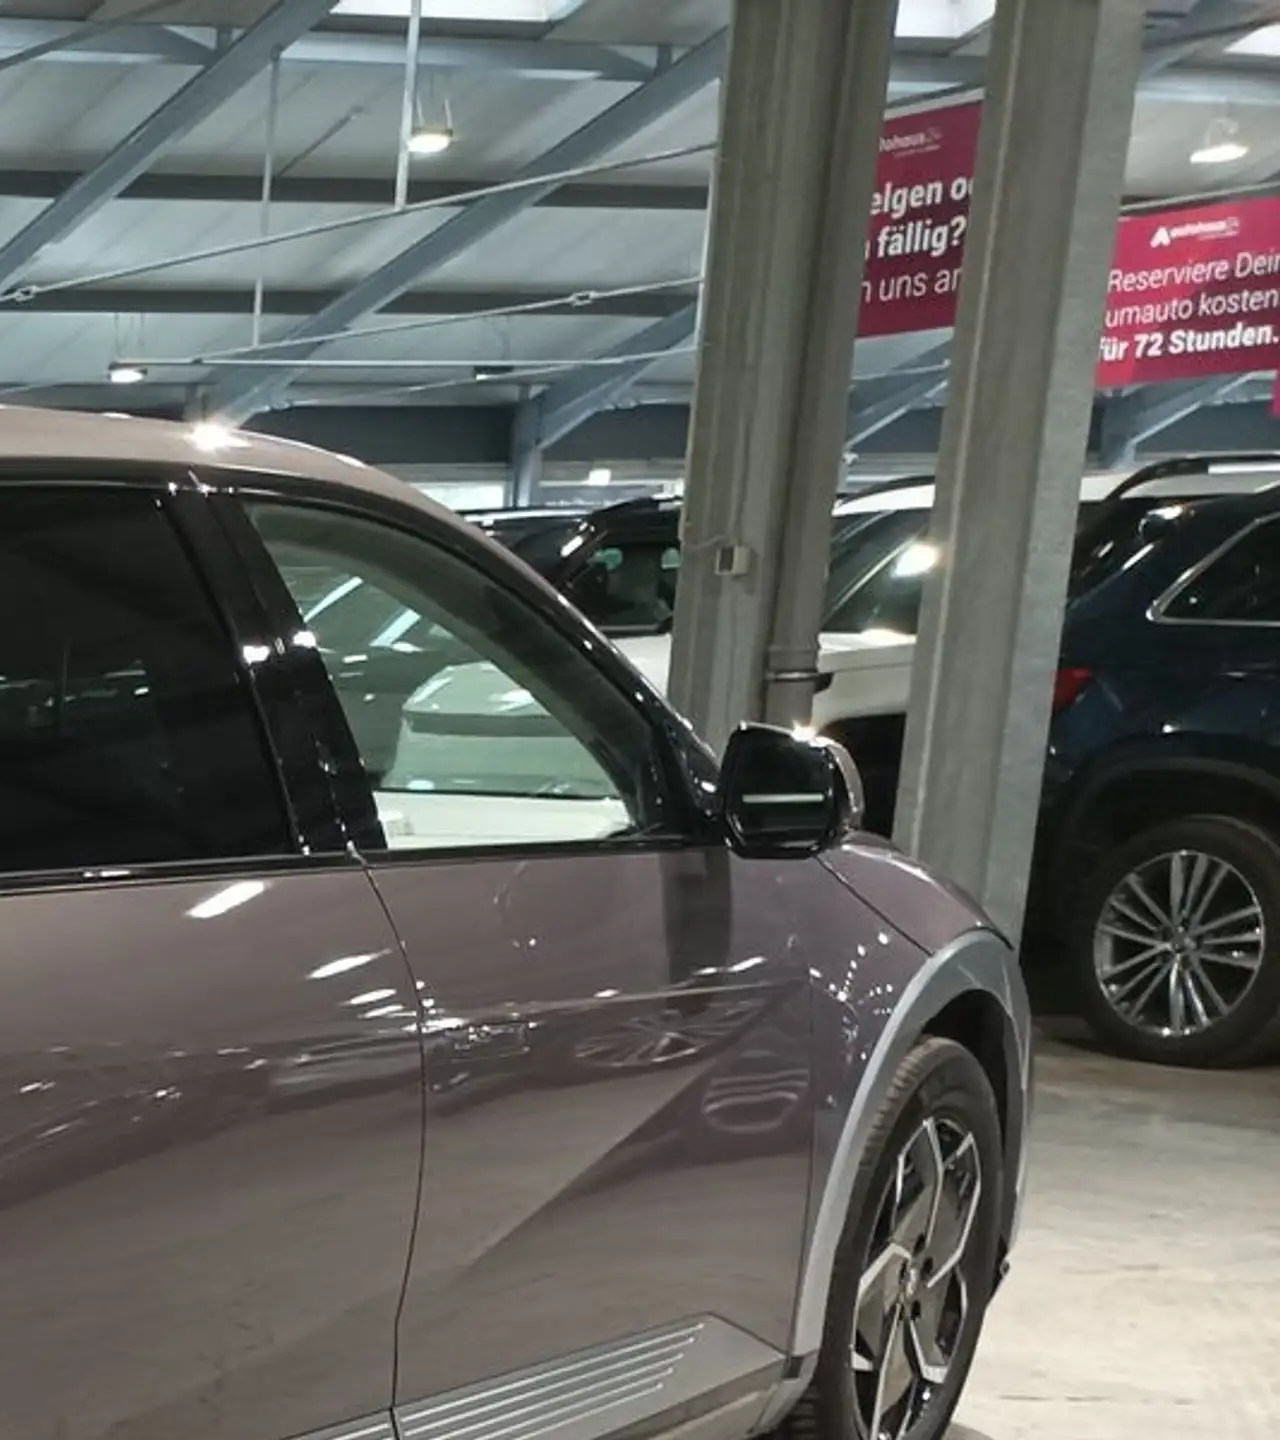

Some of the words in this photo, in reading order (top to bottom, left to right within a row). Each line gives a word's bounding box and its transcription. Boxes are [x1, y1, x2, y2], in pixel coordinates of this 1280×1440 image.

[877, 215, 967, 258] fällig?
[879, 271, 928, 302] uns
[1107, 258, 1229, 293] Reserviere
[1133, 332, 1164, 358] 72
[1169, 321, 1279, 354] Stunden.
